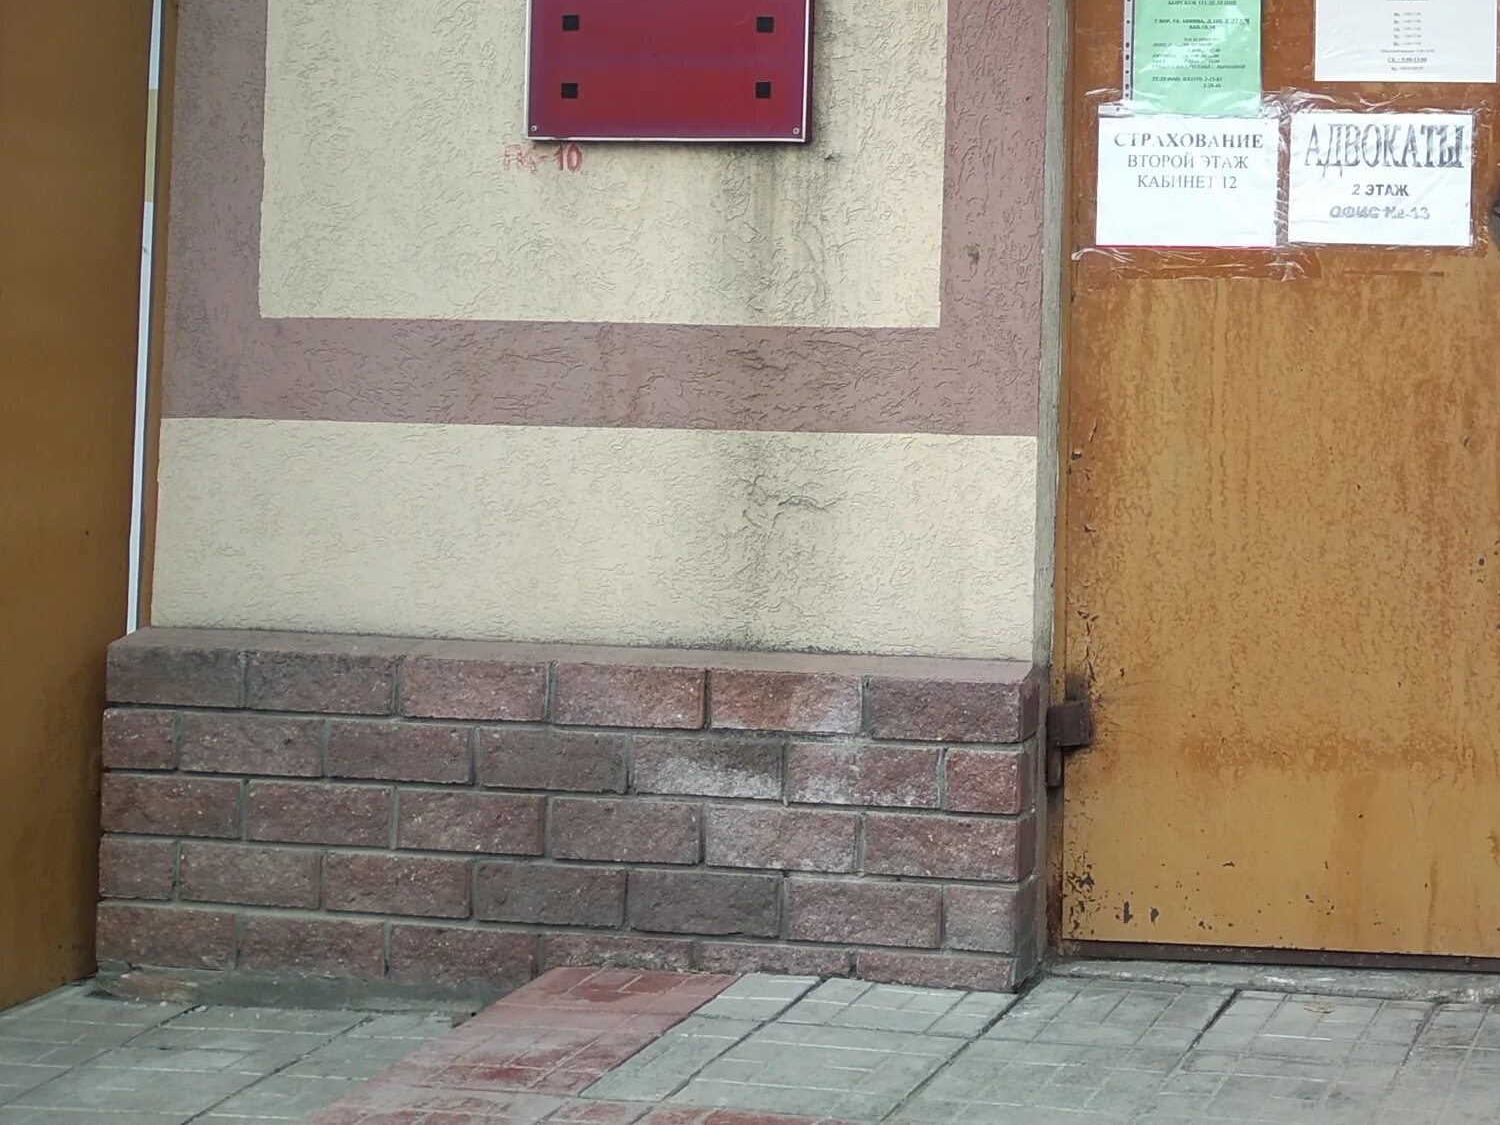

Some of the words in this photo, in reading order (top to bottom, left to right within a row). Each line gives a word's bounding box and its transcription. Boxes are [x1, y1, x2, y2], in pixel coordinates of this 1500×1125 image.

[1114, 133, 1263, 148] СТРАХОВАНИЕ
[1304, 123, 1465, 178] АДВОКАТЫ
[1128, 152, 1194, 168] ВТОРОЙ
[1201, 155, 1248, 169] ЭТАЖ
[1138, 175, 1216, 188] КАБИНЕТ
[1223, 176, 1237, 188] 12
[1352, 184, 1360, 195] 2
[1365, 184, 1409, 196] ЭТАЖ
[1330, 206, 1380, 218] ОФИС
